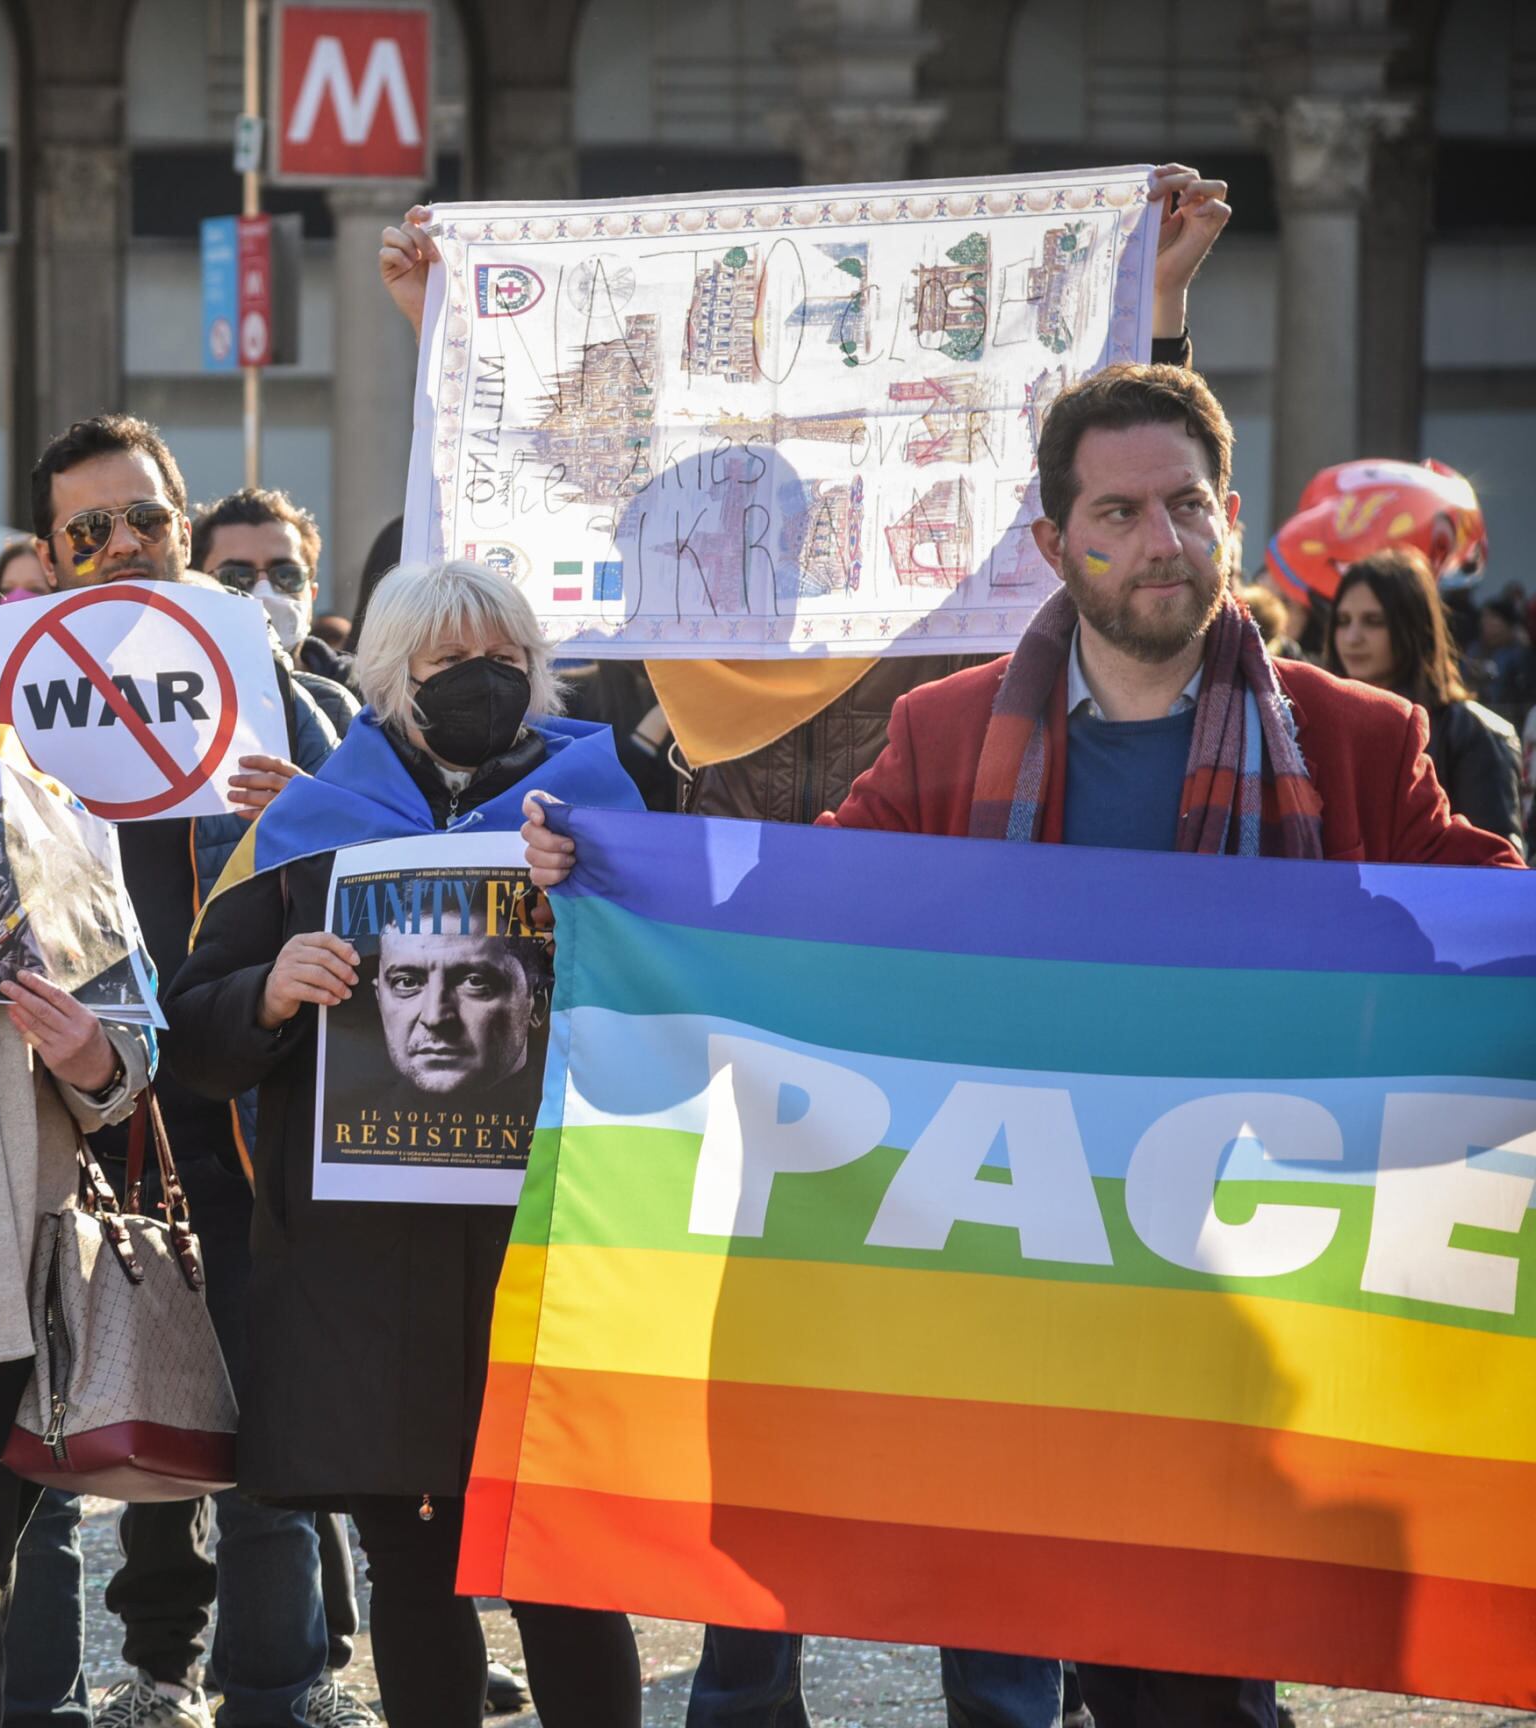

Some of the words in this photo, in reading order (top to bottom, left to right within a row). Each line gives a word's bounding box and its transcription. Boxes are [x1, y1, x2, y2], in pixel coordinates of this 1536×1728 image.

[287, 36, 421, 146] M
[22, 670, 210, 730] WAR
[339, 879, 478, 937] VANITY
[486, 880, 546, 938] FA
[335, 1123, 534, 1149] RESISTEN
[360, 1109, 381, 1121] IL
[394, 1111, 463, 1124] VOLTO
[475, 1113, 529, 1126] DELL
[688, 1033, 1536, 1316] PACE
